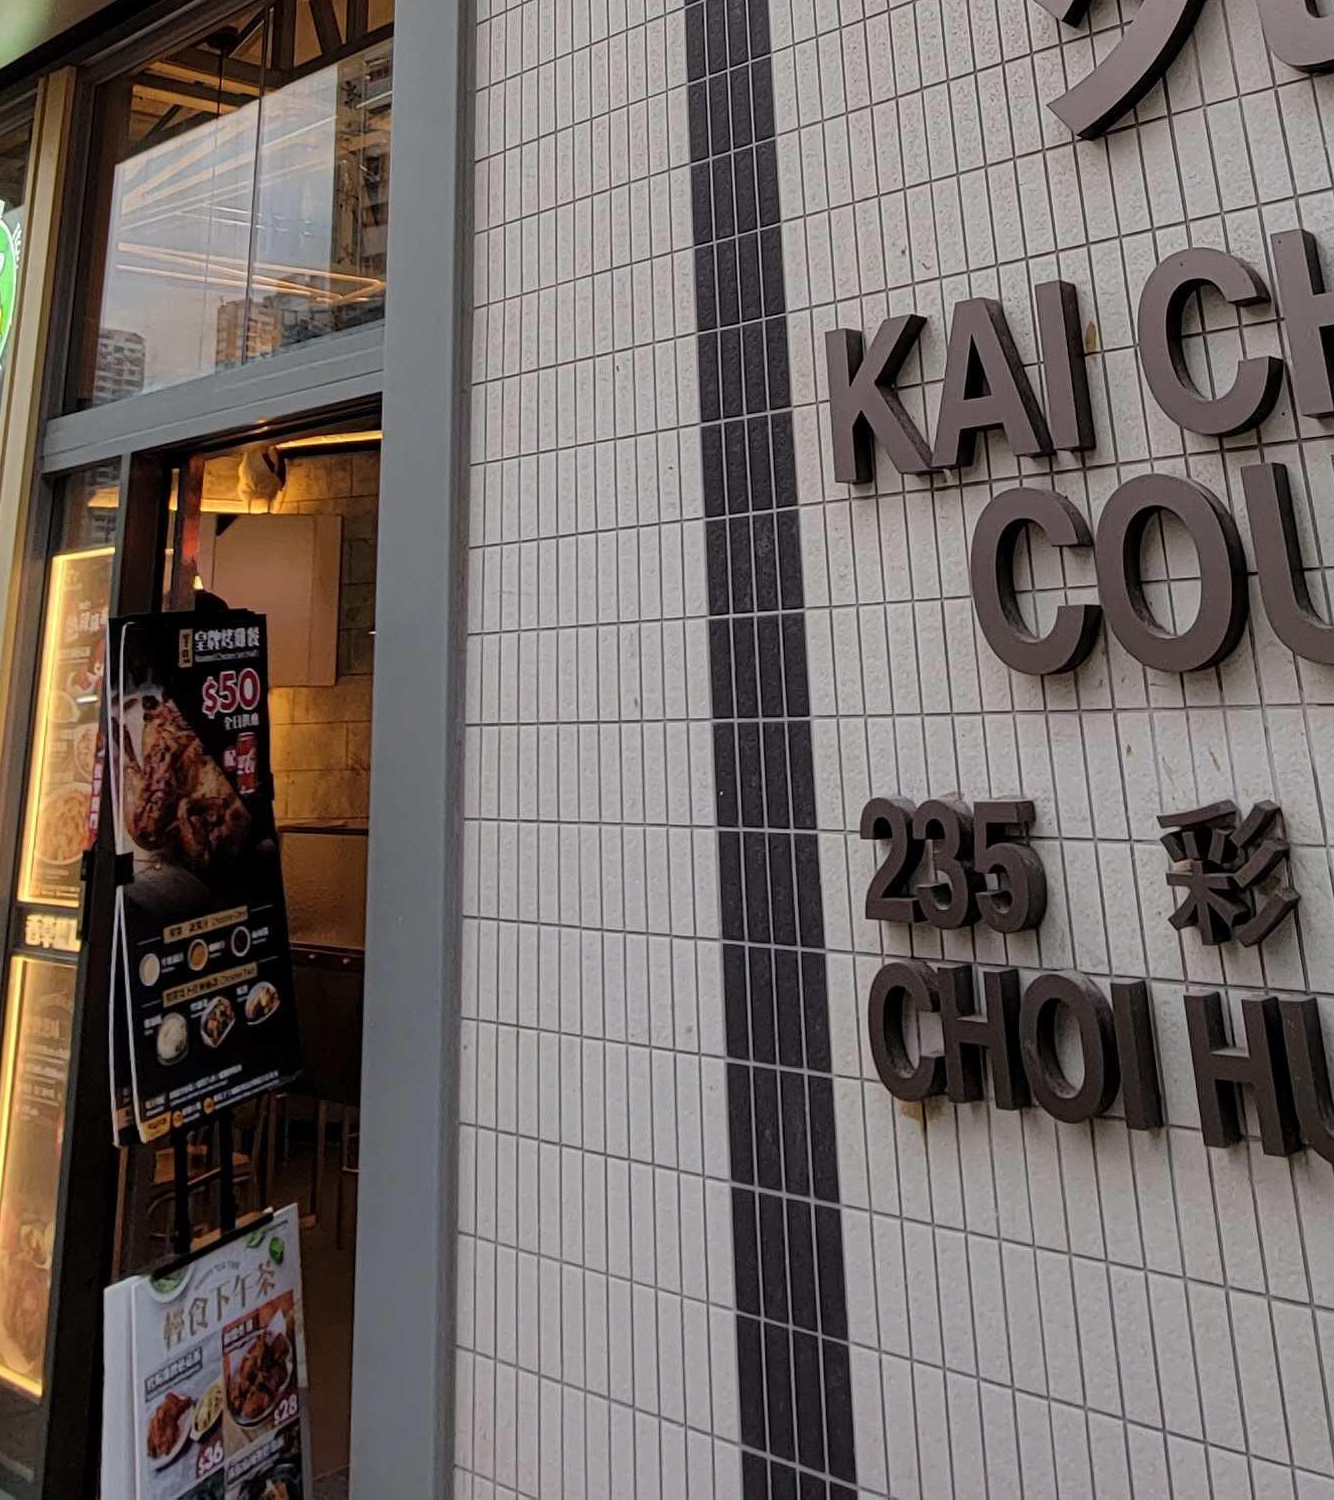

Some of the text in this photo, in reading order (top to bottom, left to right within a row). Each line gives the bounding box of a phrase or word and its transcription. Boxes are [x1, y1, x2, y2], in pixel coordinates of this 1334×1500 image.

[823, 279, 1096, 485] KAI
[202, 668, 260, 719] $50
[859, 795, 1048, 935] 235
[867, 958, 1165, 1133] CHOI
[273, 1393, 298, 1426] $28
